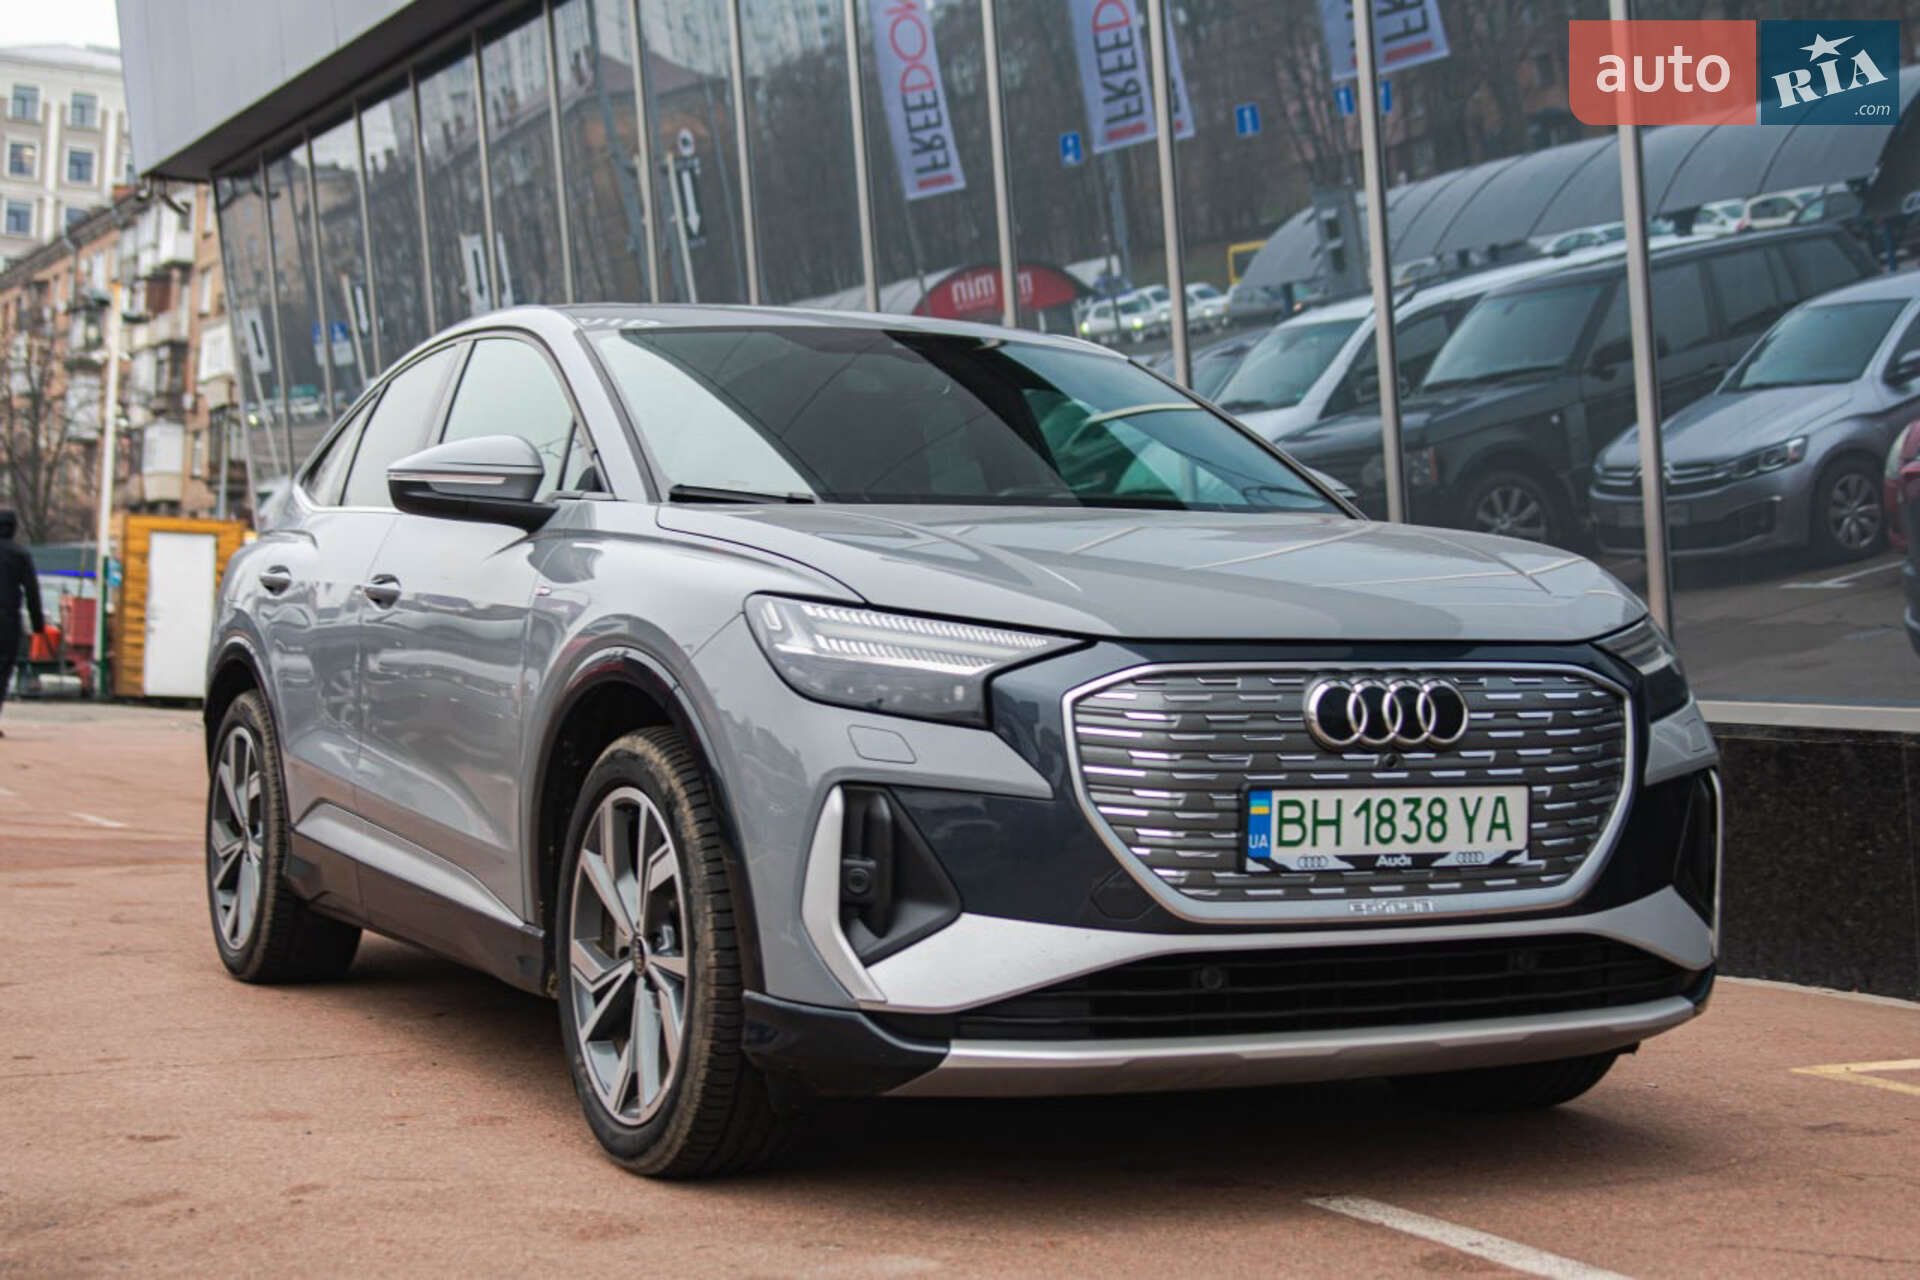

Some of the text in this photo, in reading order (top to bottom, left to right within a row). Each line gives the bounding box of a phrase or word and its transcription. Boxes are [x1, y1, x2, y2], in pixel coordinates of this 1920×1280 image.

[1276, 795, 1513, 848] BH 1838 YA
[1248, 834, 1269, 849] UA
[1375, 853, 1413, 867] Audi
